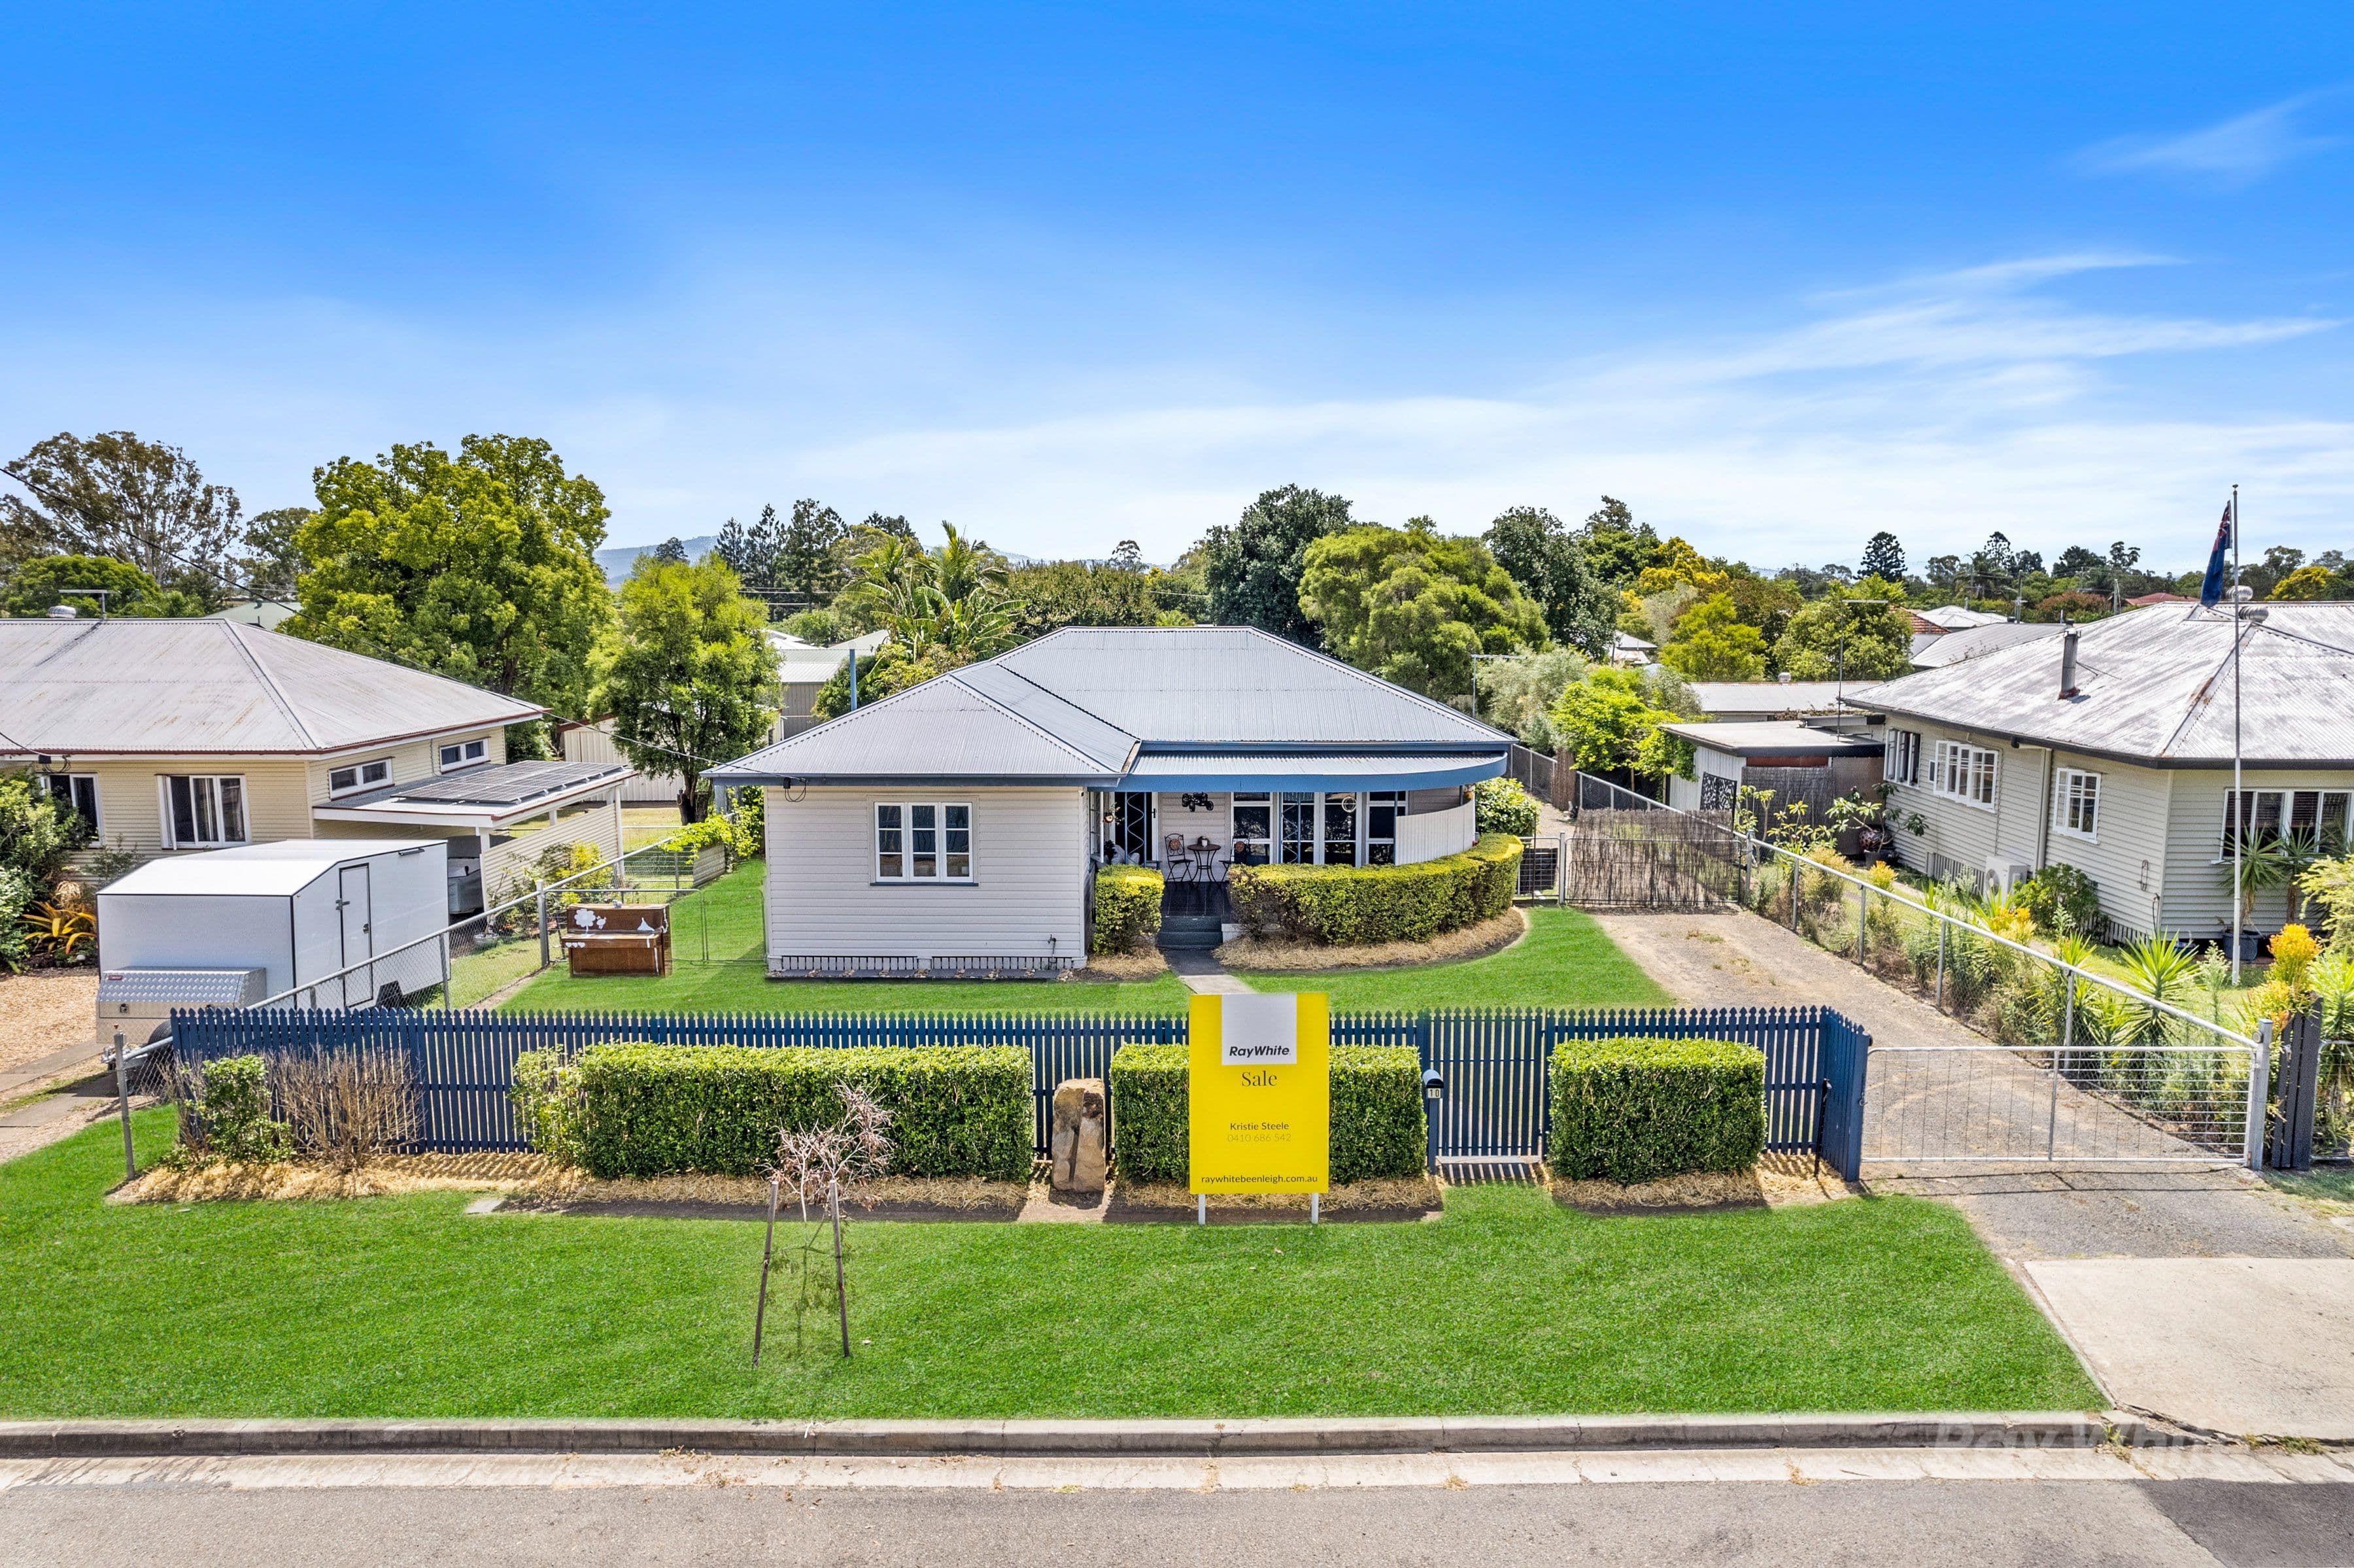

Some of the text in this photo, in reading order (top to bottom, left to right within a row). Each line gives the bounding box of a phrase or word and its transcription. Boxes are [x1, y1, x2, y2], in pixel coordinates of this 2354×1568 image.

[1242, 1070, 1277, 1086] Sale
[1429, 1089, 1439, 1097] 10
[1230, 1122, 1259, 1131] Kristie
[1227, 1134, 1252, 1142] 0410
[1275, 1133, 1291, 1142] 542
[1201, 1174, 1318, 1184] raywhitebeenleigh.com.au
